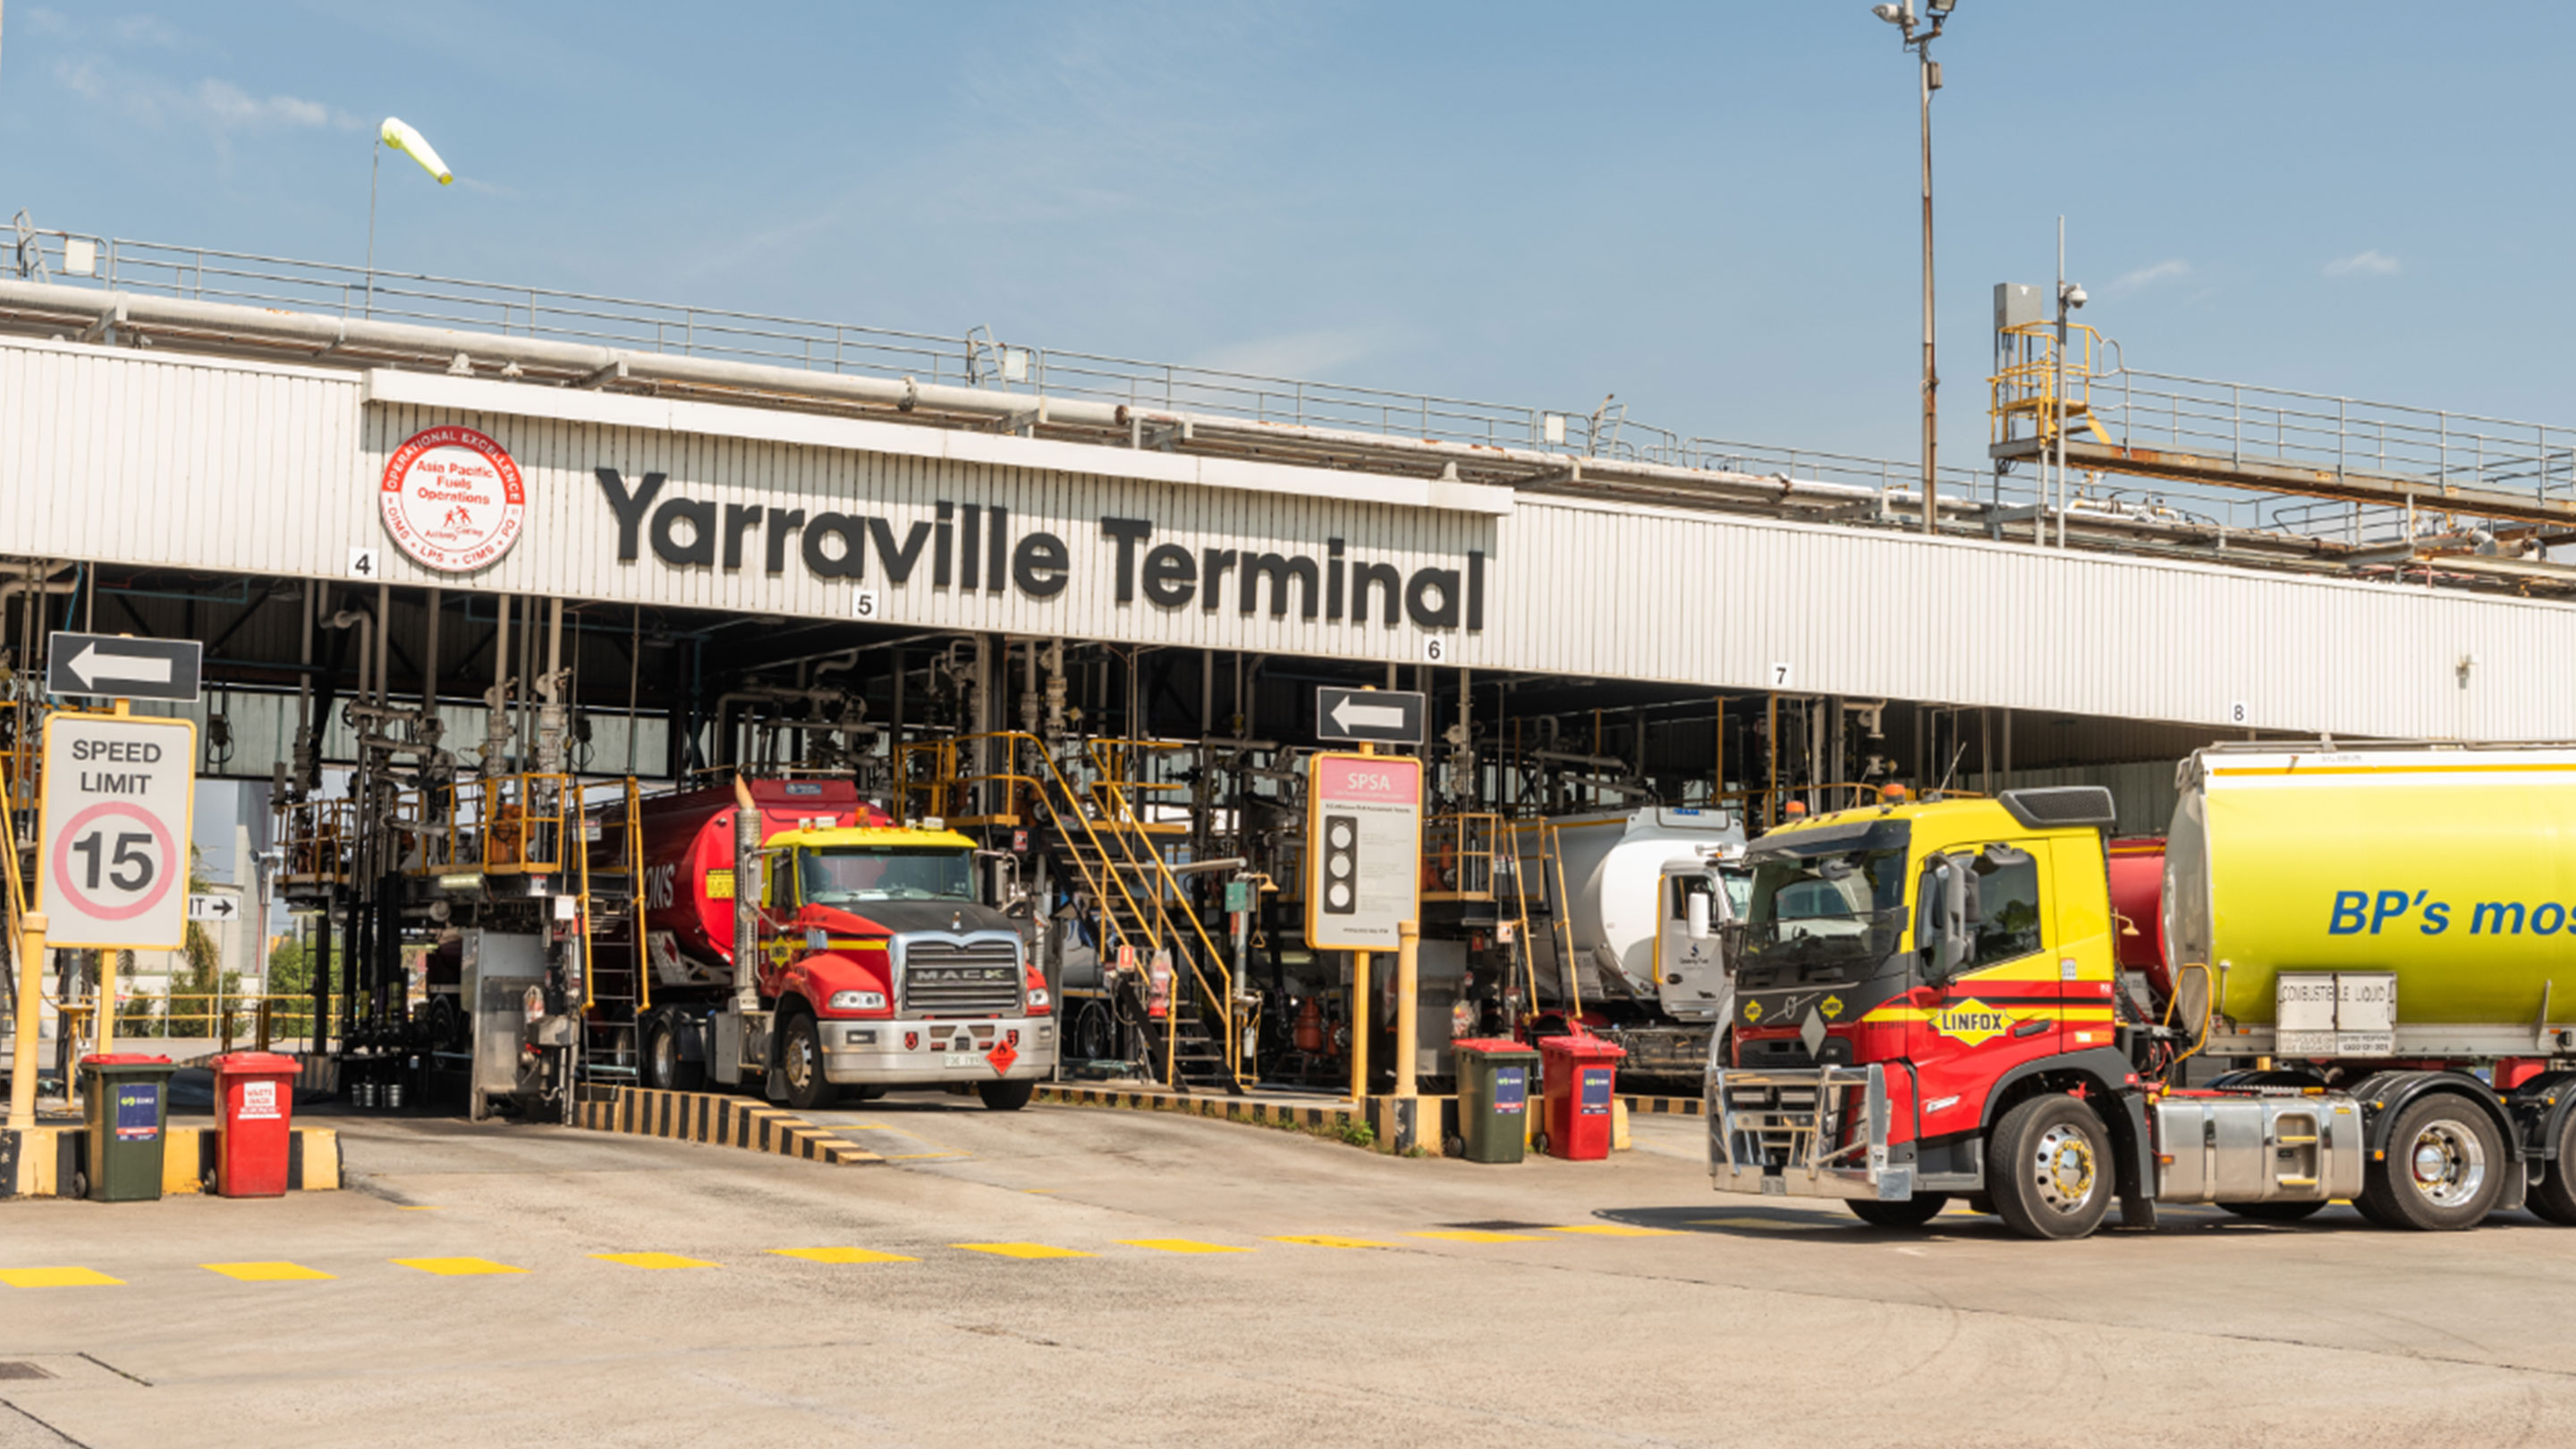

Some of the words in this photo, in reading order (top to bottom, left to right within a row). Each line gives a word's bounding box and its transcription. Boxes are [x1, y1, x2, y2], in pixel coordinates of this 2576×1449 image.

[386, 430, 457, 490] OPERATIONAL
[461, 432, 521, 501] EXCELLENCE
[416, 460, 445, 474] Asia
[449, 462, 494, 479] Pacific
[436, 476, 472, 490] Fuels
[417, 487, 491, 505] Operations
[596, 467, 1070, 597] Yarraville
[1101, 516, 1485, 631] Terminal
[354, 554, 371, 575] 4
[857, 594, 873, 616] 5
[1428, 640, 1441, 660] 6
[1775, 666, 1787, 685] 7
[2234, 704, 2244, 722] 8
[72, 739, 163, 763] SPEED
[80, 771, 152, 794] LIMIT
[1347, 772, 1392, 792] SPSA
[72, 831, 154, 891] 15
[2327, 890, 2452, 936] BP's
[915, 970, 1004, 980] MACK
[1943, 1013, 2003, 1030] LINFOX
